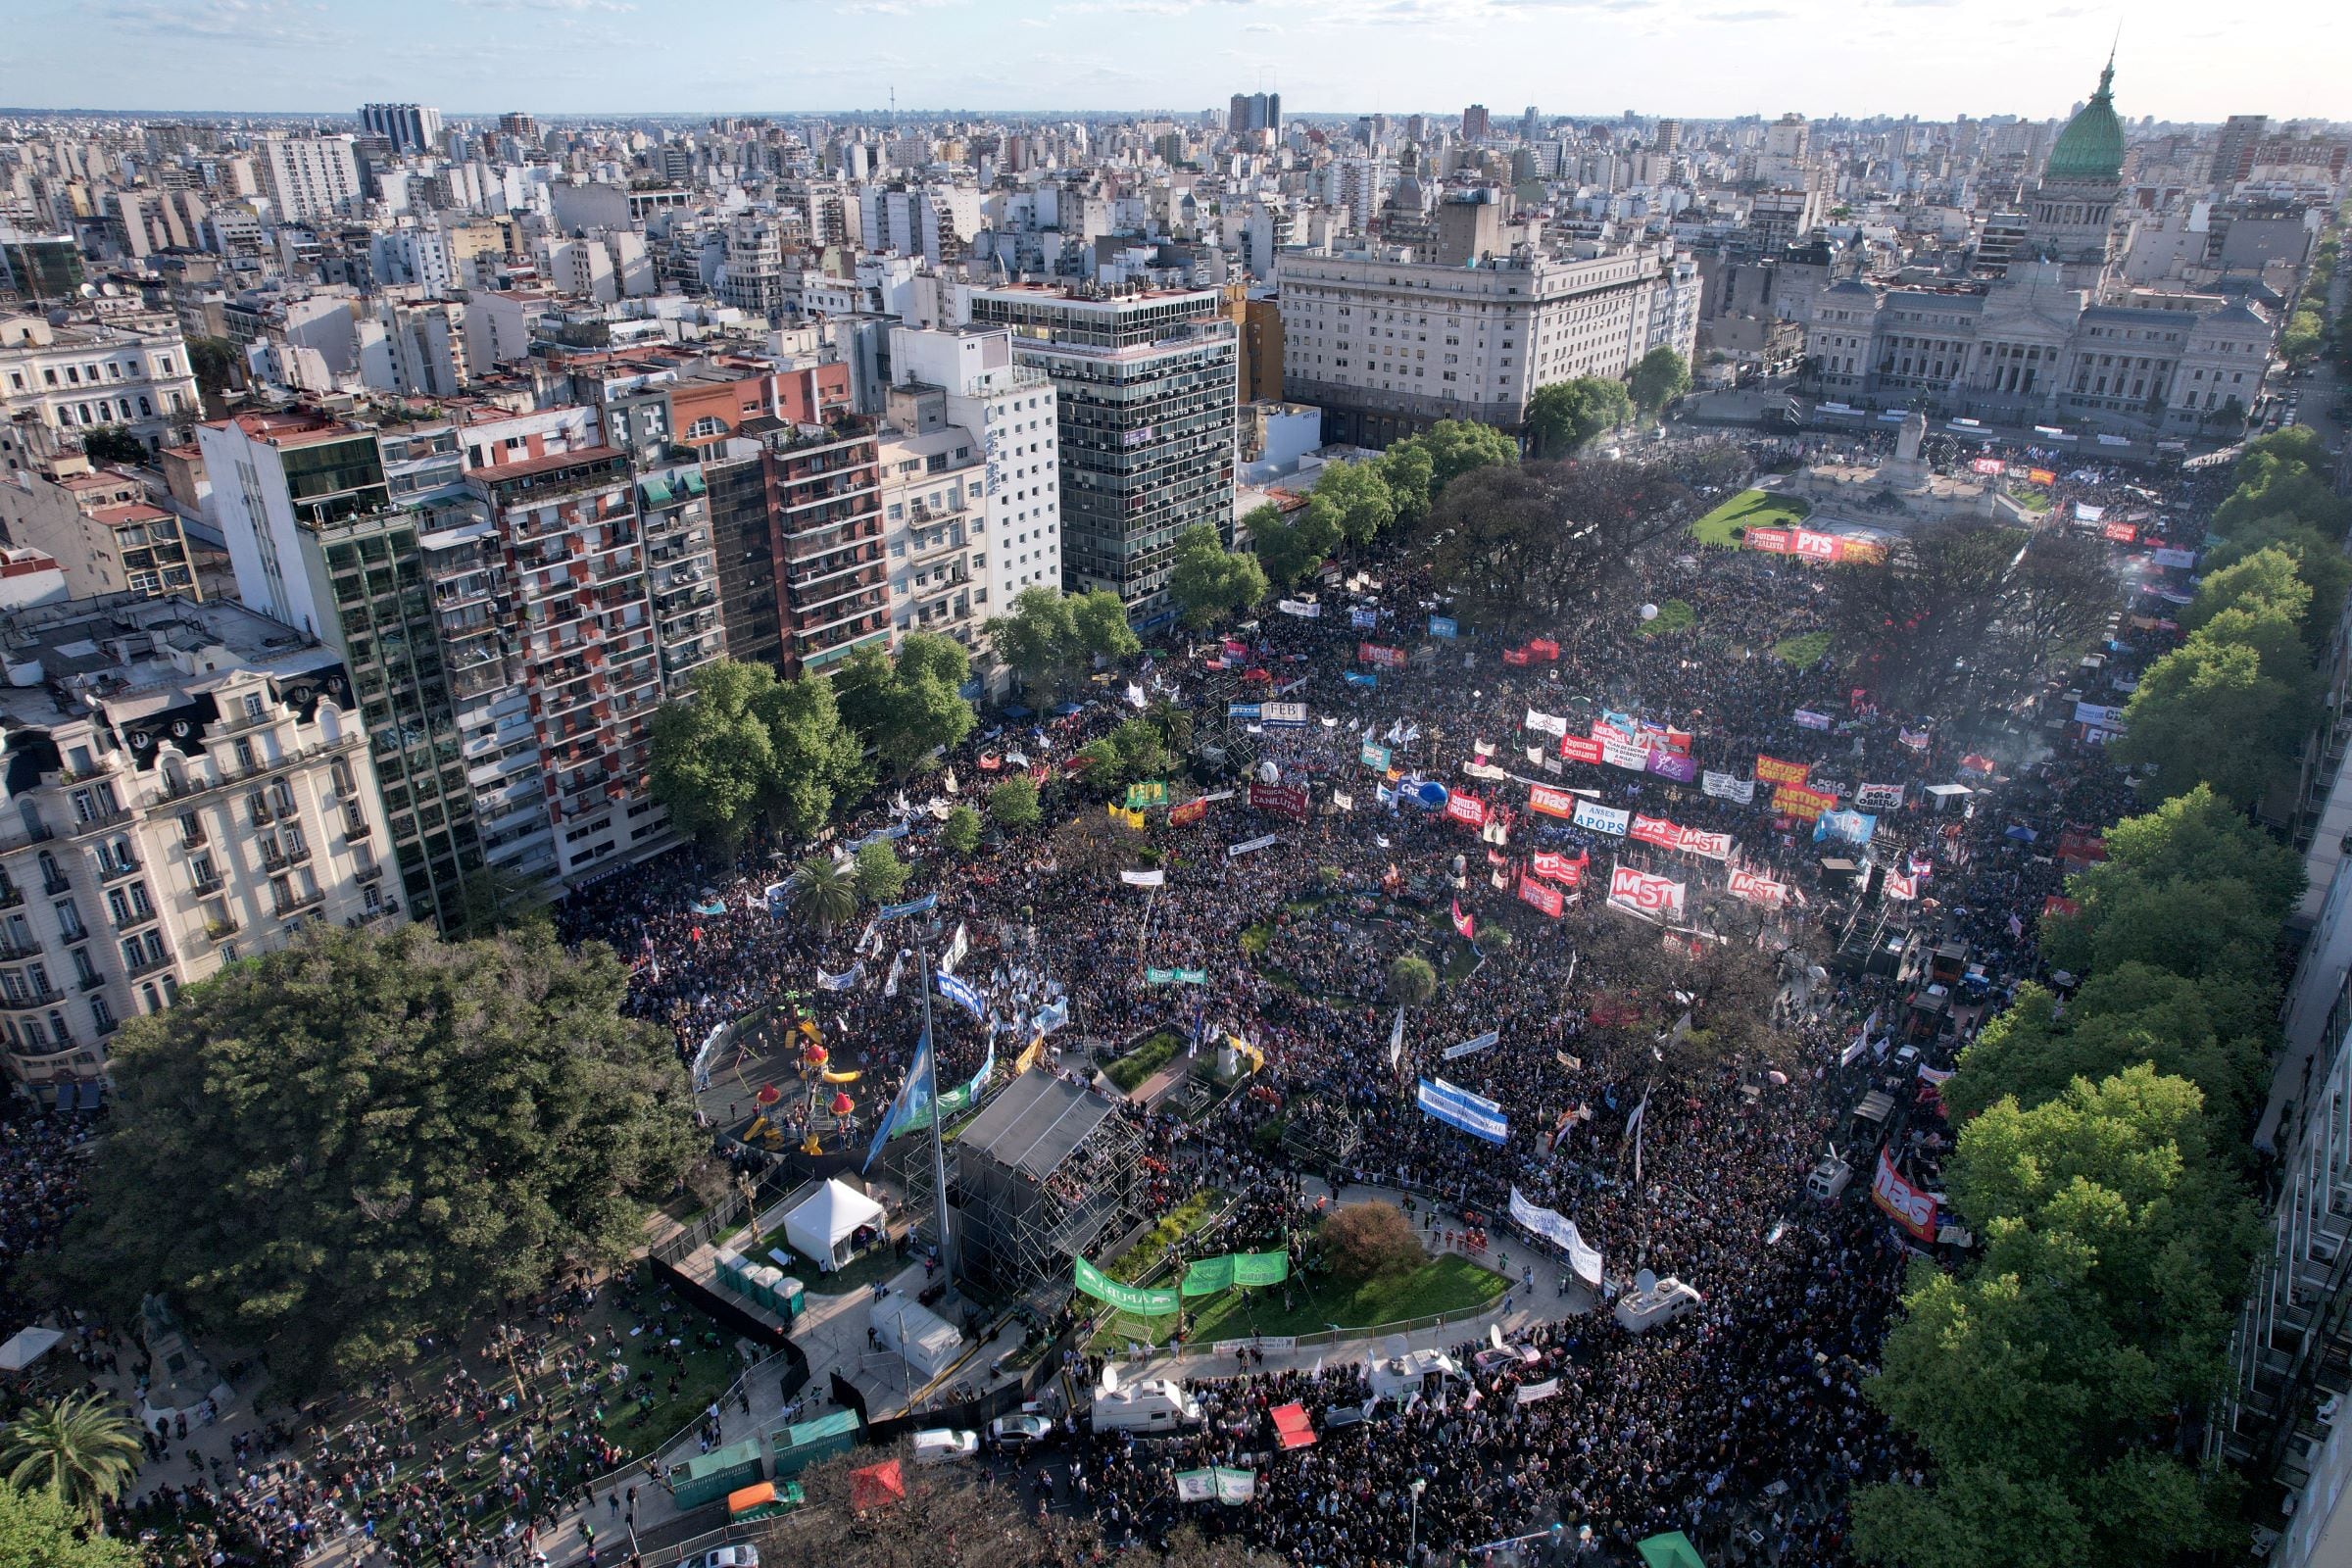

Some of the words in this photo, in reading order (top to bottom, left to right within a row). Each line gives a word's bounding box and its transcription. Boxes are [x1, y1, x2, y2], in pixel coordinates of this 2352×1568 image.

[1797, 532, 1833, 554] PTS
[1269, 703, 1297, 715] FEB
[1757, 757, 1806, 776] PARTIDO
[1757, 767, 1802, 783] OBRERO
[1817, 778, 1846, 790] POLO
[1256, 788, 1289, 797] SINDICATO
[1289, 793, 1297, 802] DE
[1532, 788, 1571, 809] mas
[1775, 787, 1834, 809] PARTIDO
[1859, 798, 1899, 808] OBRERO
[1253, 796, 1300, 812] CANILLITAS
[1589, 807, 1615, 818] ANSES
[1575, 814, 1625, 835] APOPS
[1635, 818, 1665, 833] PTS
[1683, 830, 1723, 852] MST
[1616, 872, 1675, 909] MST
[1734, 874, 1778, 902] MST
